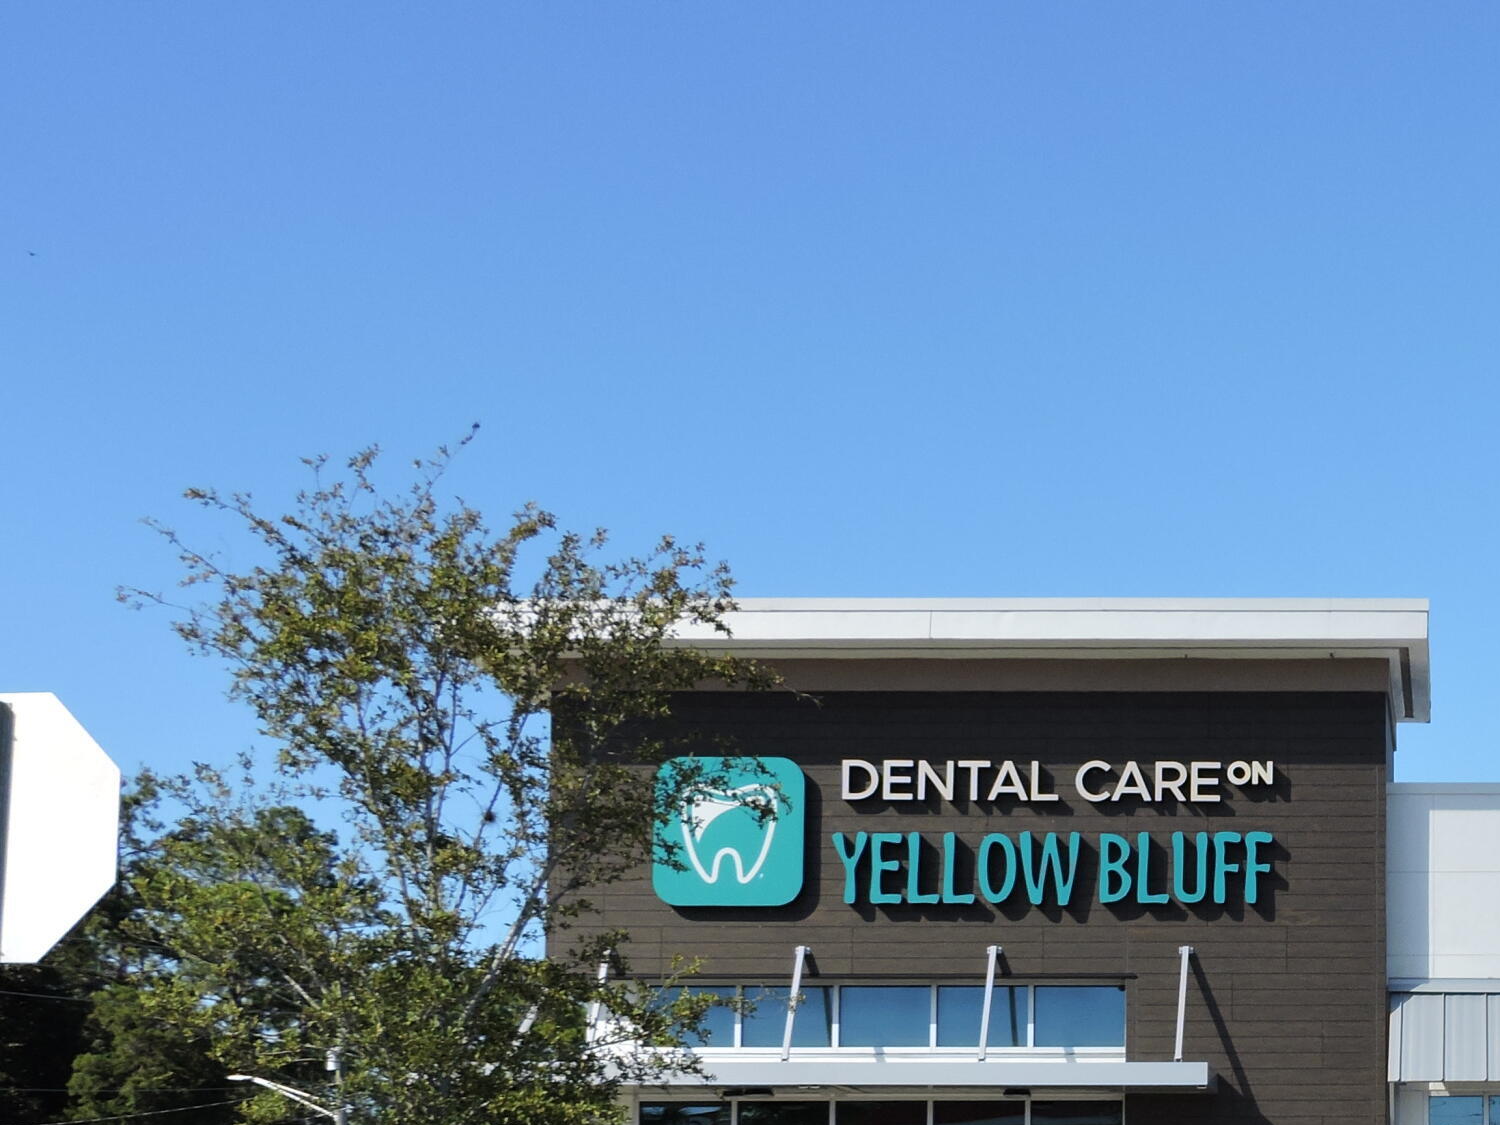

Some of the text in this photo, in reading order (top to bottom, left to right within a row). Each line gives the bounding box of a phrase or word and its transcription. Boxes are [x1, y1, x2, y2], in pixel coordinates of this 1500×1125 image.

[841, 759, 1274, 802] DENTAL CARE ON
[831, 830, 1274, 906] YELLOW BLUFF
